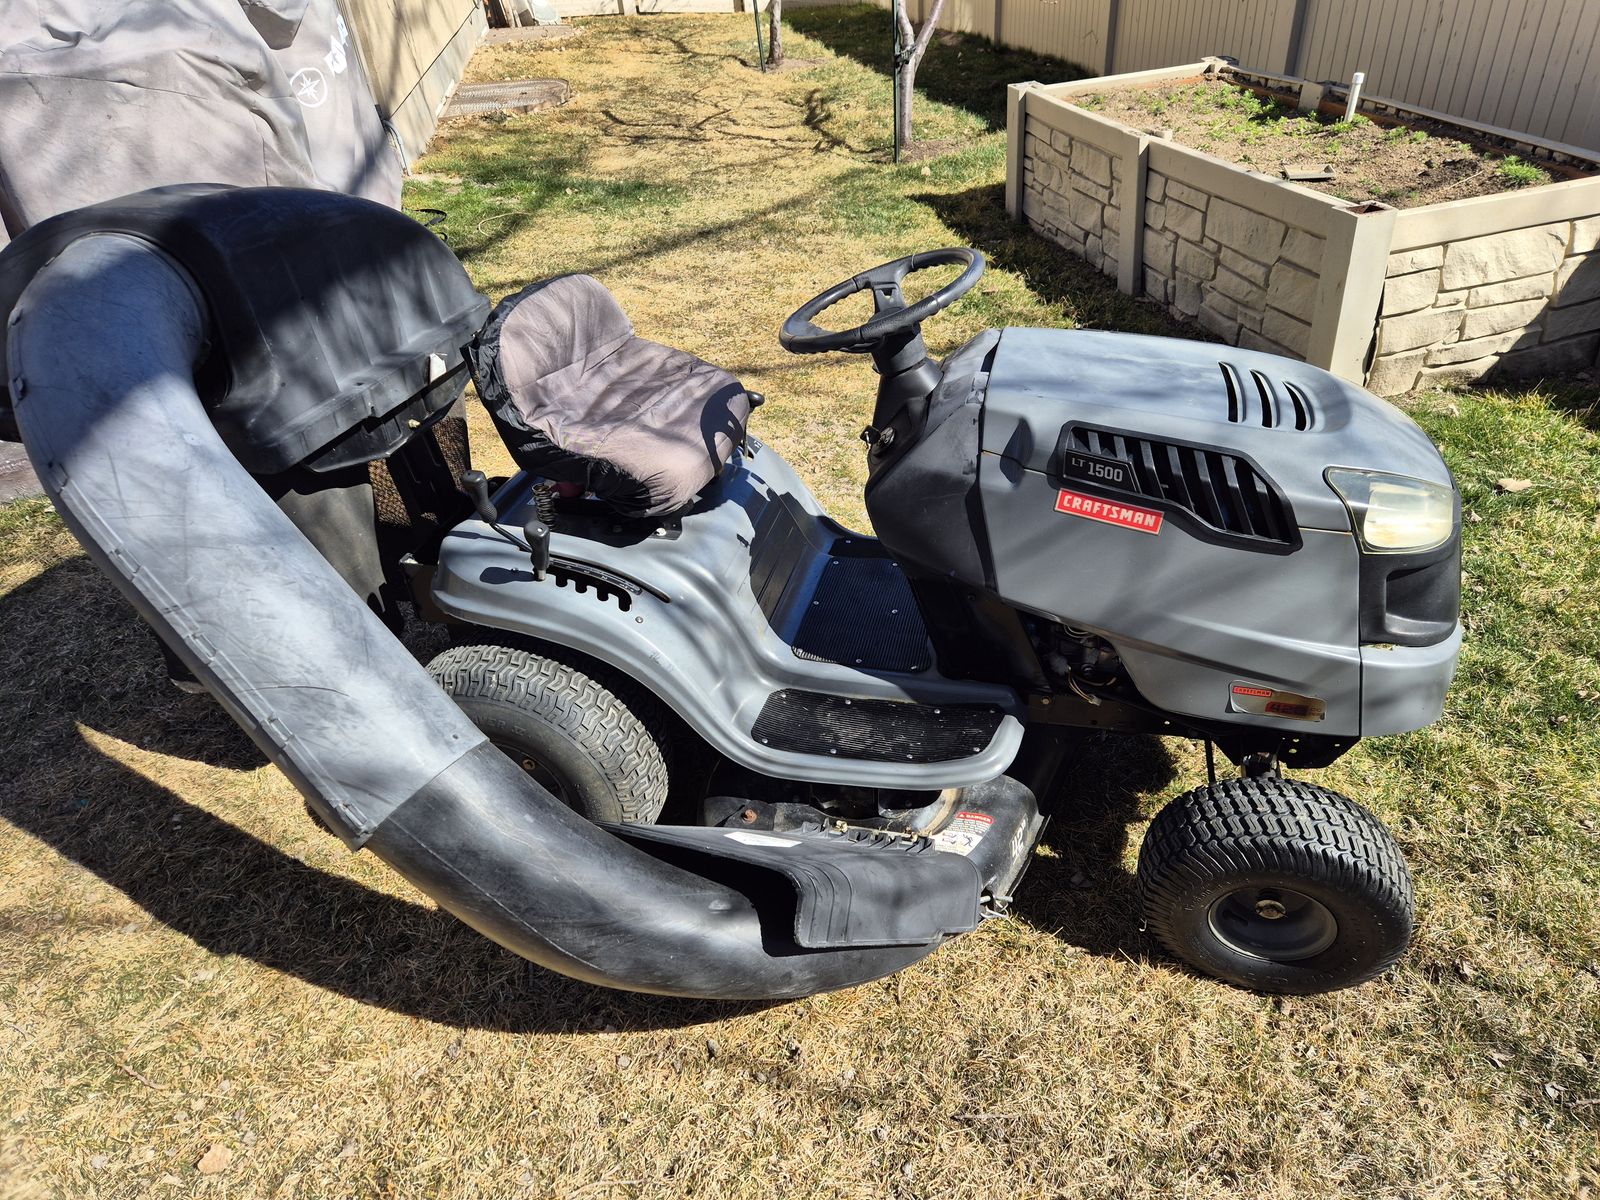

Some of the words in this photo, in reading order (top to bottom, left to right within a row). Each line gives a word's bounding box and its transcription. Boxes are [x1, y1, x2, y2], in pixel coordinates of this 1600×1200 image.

[1071, 457, 1086, 468] LT
[1087, 462, 1123, 482] 1500
[1063, 494, 1156, 527] CRAFTSMAN
[966, 813, 991, 823] DANGER
